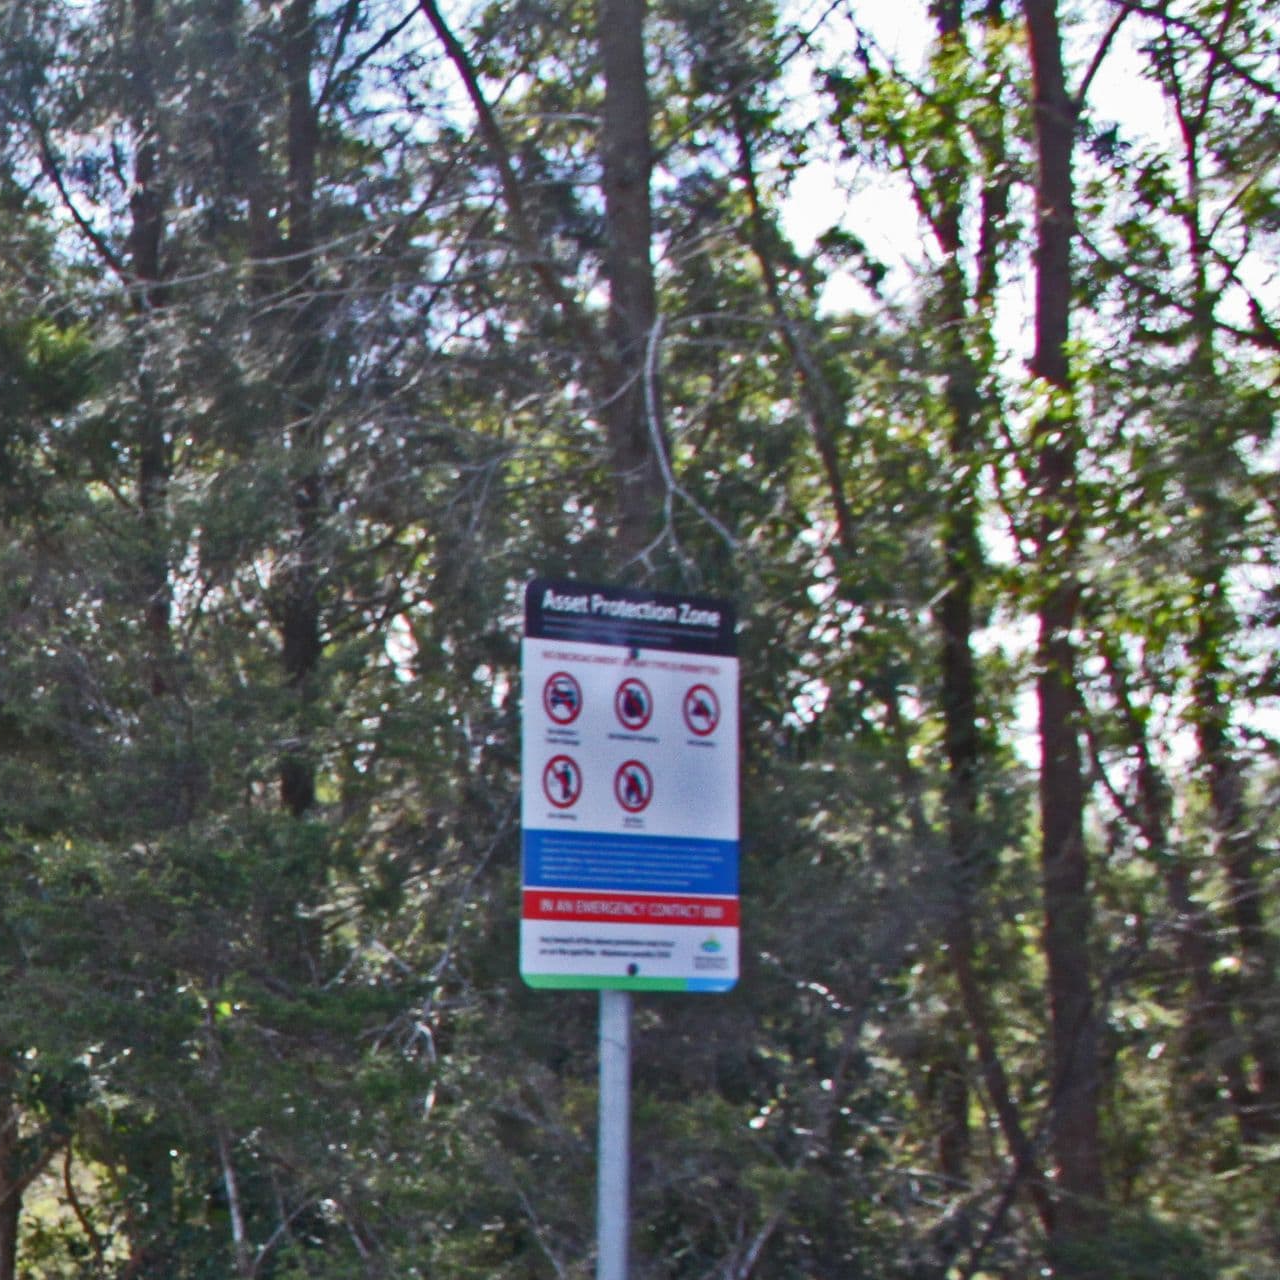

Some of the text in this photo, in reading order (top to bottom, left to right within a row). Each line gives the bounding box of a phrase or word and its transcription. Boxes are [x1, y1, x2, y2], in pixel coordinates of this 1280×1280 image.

[542, 588, 588, 613] Asset
[590, 593, 677, 621] Protection
[678, 603, 721, 627] Zone
